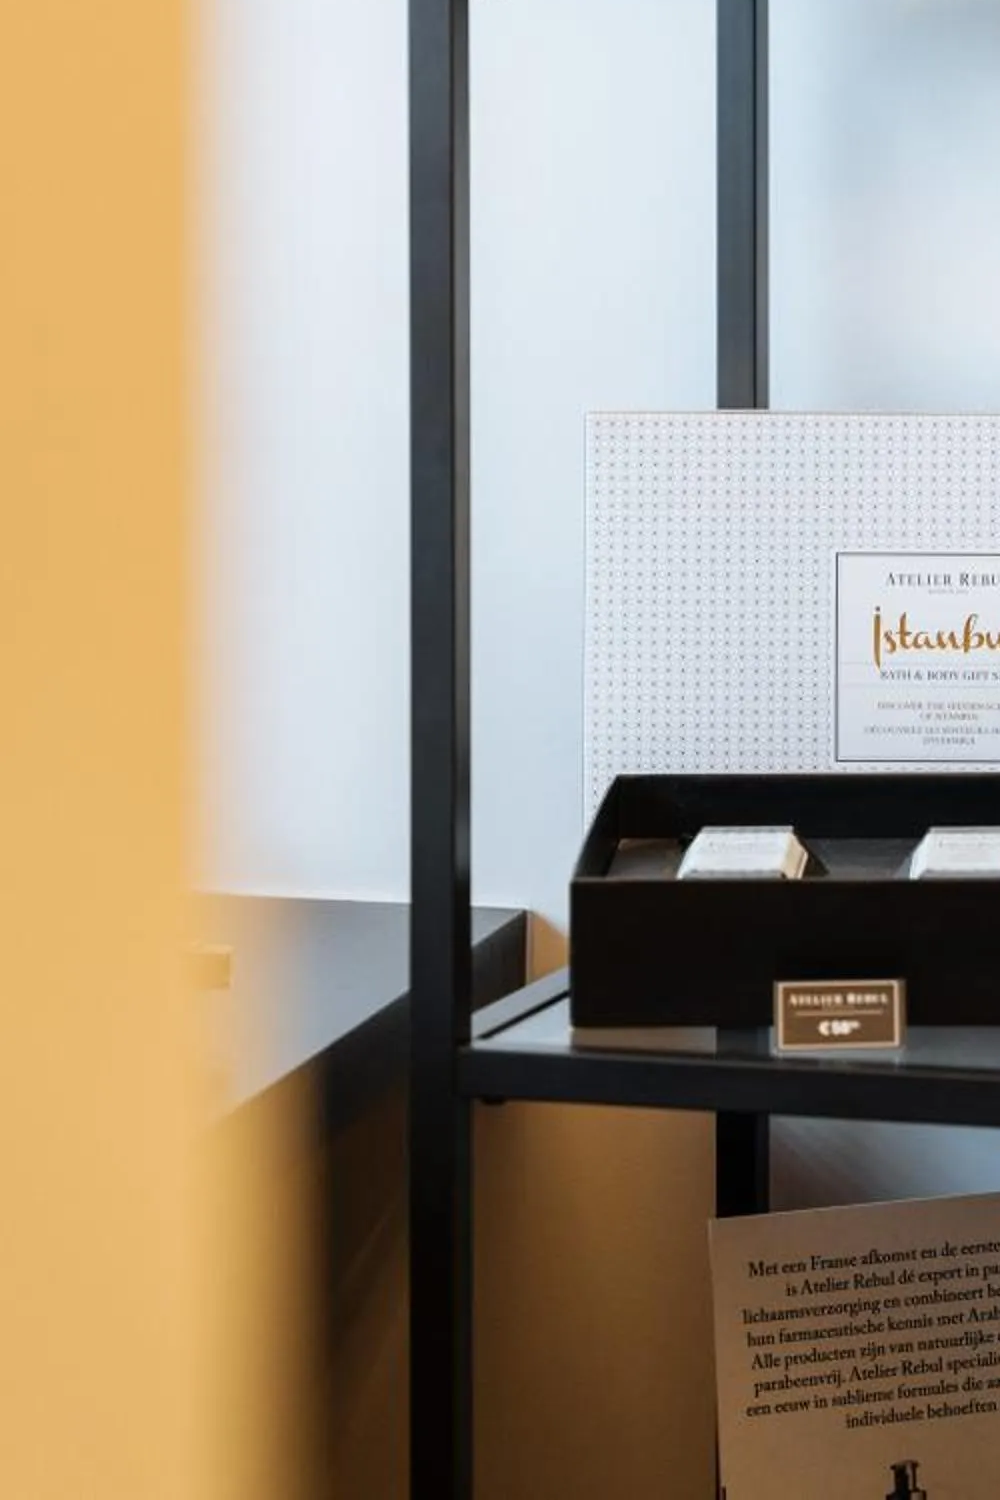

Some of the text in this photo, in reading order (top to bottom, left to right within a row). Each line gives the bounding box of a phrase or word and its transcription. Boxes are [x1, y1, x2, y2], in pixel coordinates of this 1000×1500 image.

[886, 571, 952, 587] ATELIER
[749, 1260, 777, 1277] Met
[782, 1260, 806, 1273] een
[811, 1253, 856, 1270] Franse
[861, 1246, 917, 1265] afkomst
[922, 1246, 936, 1259] en
[941, 1240, 957, 1257] de
[961, 1239, 1000, 1255] eerste
[786, 1281, 797, 1297] is
[801, 1276, 849, 1295] Atelier
[853, 1269, 894, 1289] Rebul
[918, 1264, 962, 1286] expert
[966, 1261, 979, 1277] in
[743, 1296, 881, 1324] lichaamsverzorging
[884, 1296, 900, 1309] en
[904, 1285, 983, 1307] combineert
[747, 1330, 774, 1347] hun
[779, 1317, 884, 1344] farmaceutische
[888, 1313, 932, 1332] kennis
[937, 1310, 963, 1326] met
[751, 1351, 780, 1370] Alle
[784, 1347, 855, 1371] producten
[860, 1341, 885, 1362] zijn
[890, 1341, 913, 1355] van
[918, 1327, 994, 1351] natuurlijke
[754, 1368, 845, 1397] parabeenvrij.
[850, 1363, 897, 1382] Atelier
[901, 1356, 942, 1376] Rebul
[746, 1403, 771, 1417] een
[775, 1398, 810, 1413] eeuw
[814, 1393, 828, 1409] in
[832, 1387, 893, 1407] sublieme
[897, 1379, 958, 1400] formules
[962, 1376, 984, 1393] die
[846, 1404, 924, 1428] individuele
[927, 1397, 997, 1419] behoeften
